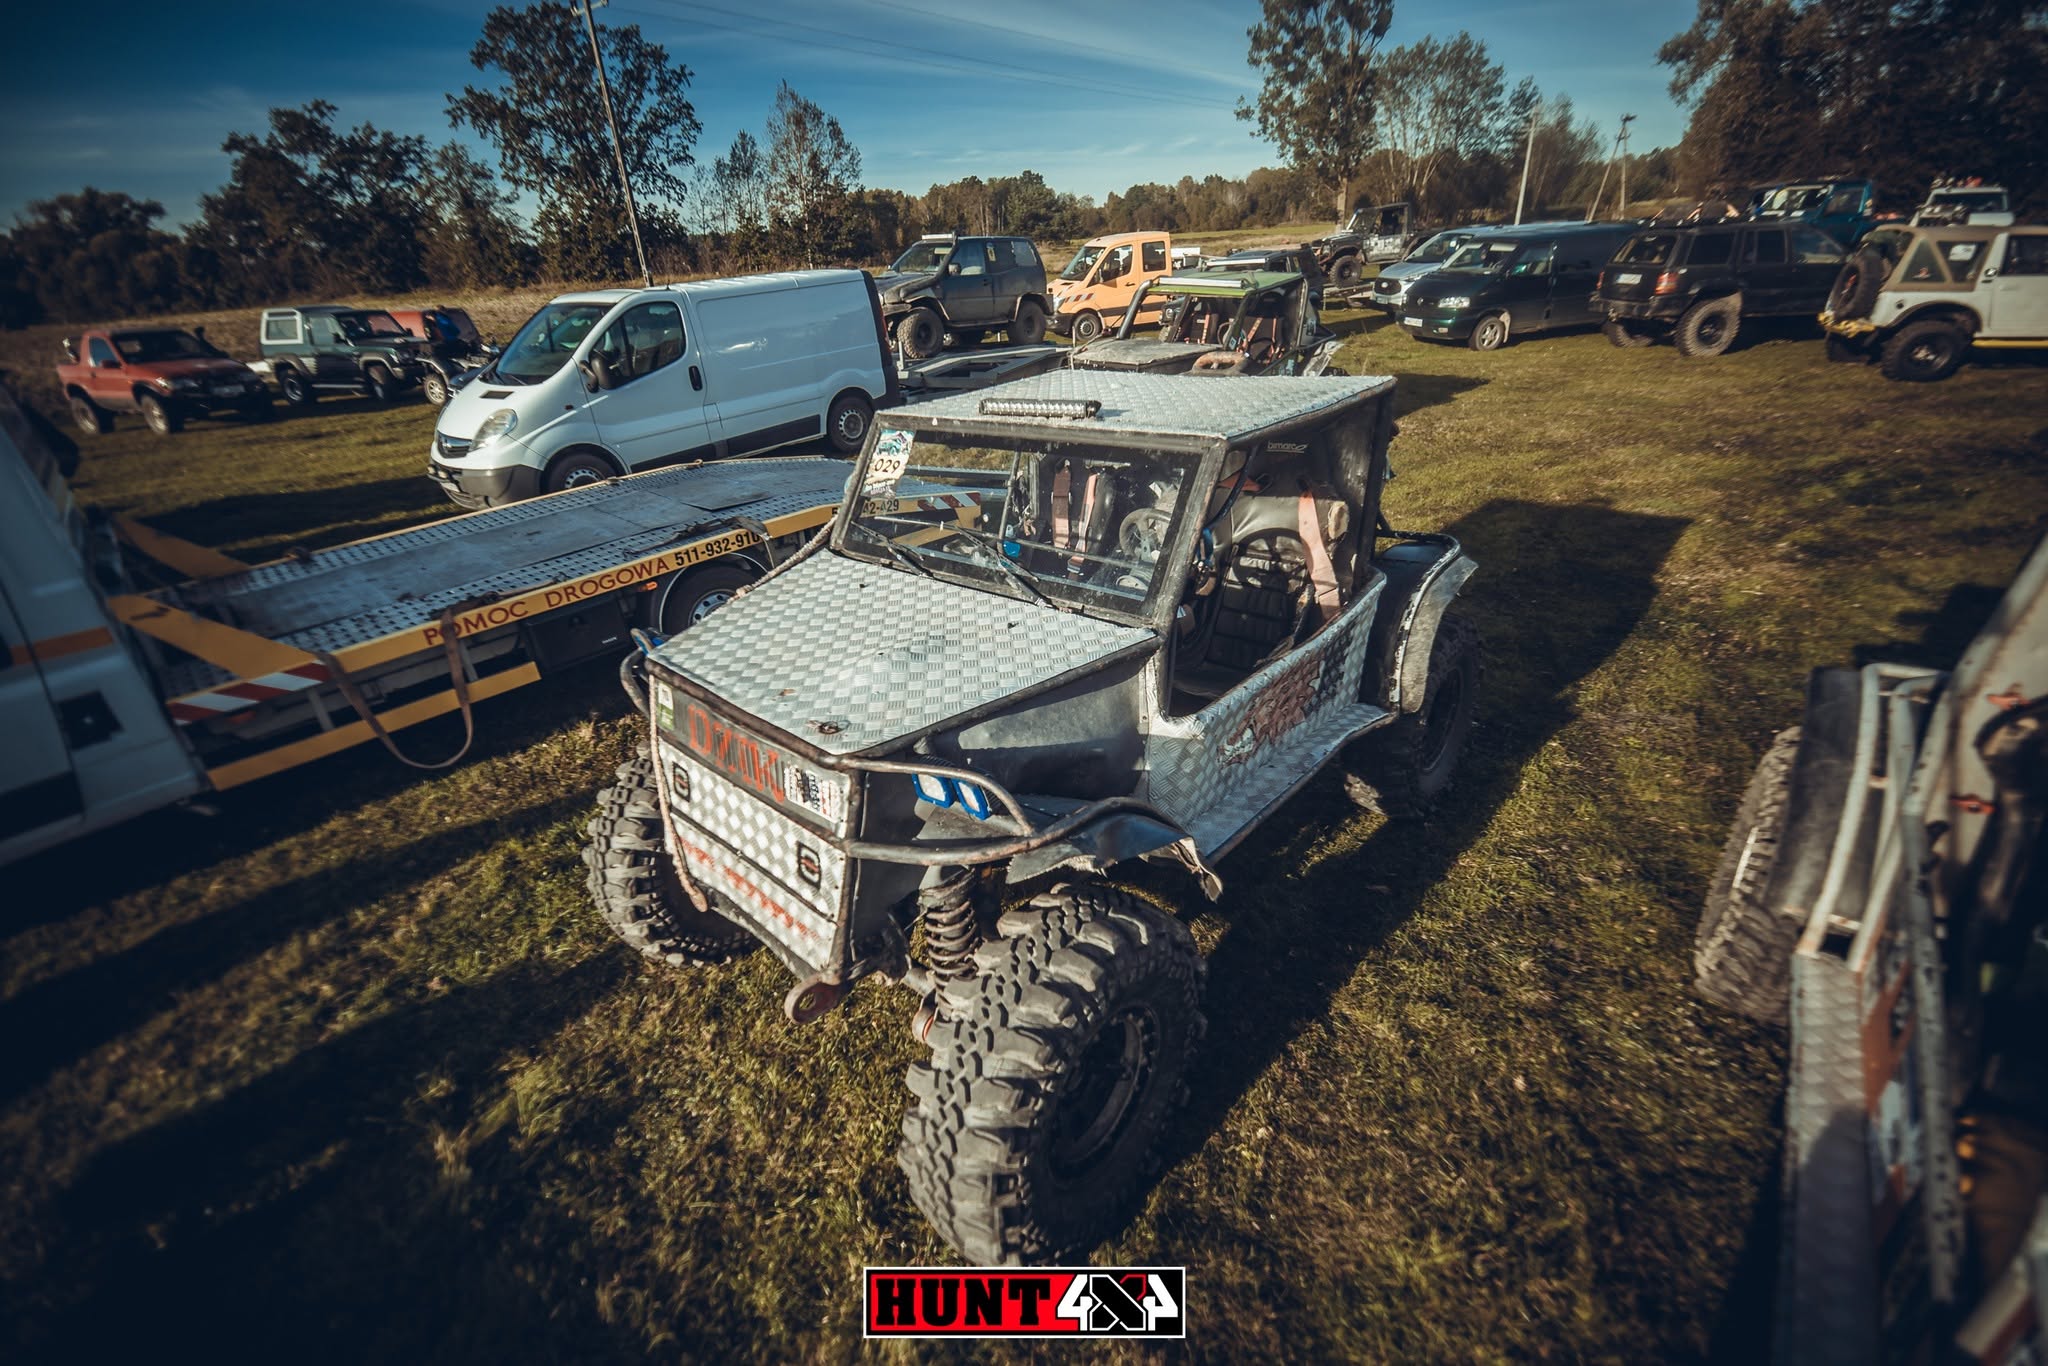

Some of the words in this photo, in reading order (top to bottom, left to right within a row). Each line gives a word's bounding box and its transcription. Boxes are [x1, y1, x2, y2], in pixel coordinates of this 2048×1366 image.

[1267, 441, 1309, 451] bimarco
[874, 458, 901, 474] 029
[544, 557, 670, 608] DROGOWA
